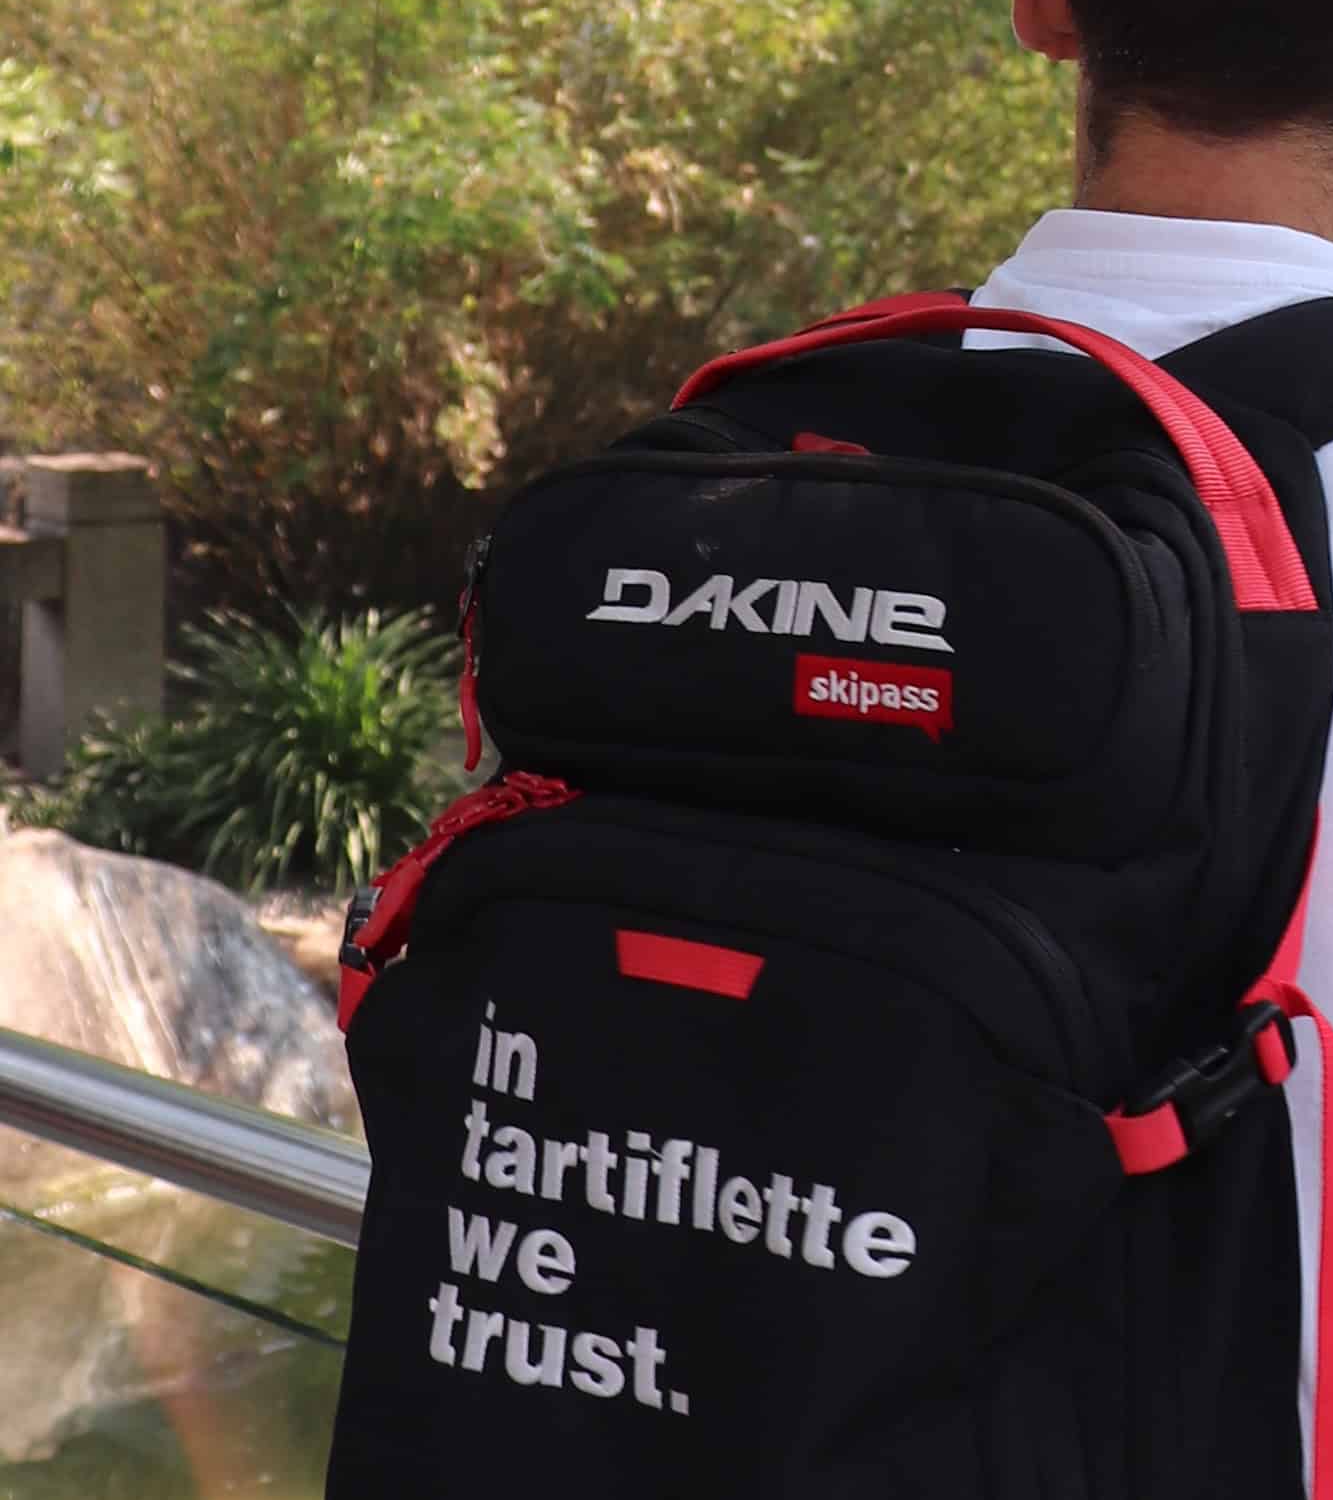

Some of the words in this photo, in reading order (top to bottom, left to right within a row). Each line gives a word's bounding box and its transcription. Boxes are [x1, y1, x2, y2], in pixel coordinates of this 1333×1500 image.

[585, 568, 955, 653] DAKINE
[809, 670, 939, 714] skipass
[473, 1001, 538, 1101] in
[461, 1099, 916, 1278] tartiflette
[447, 1206, 576, 1295] we
[429, 1282, 689, 1415] trust.
